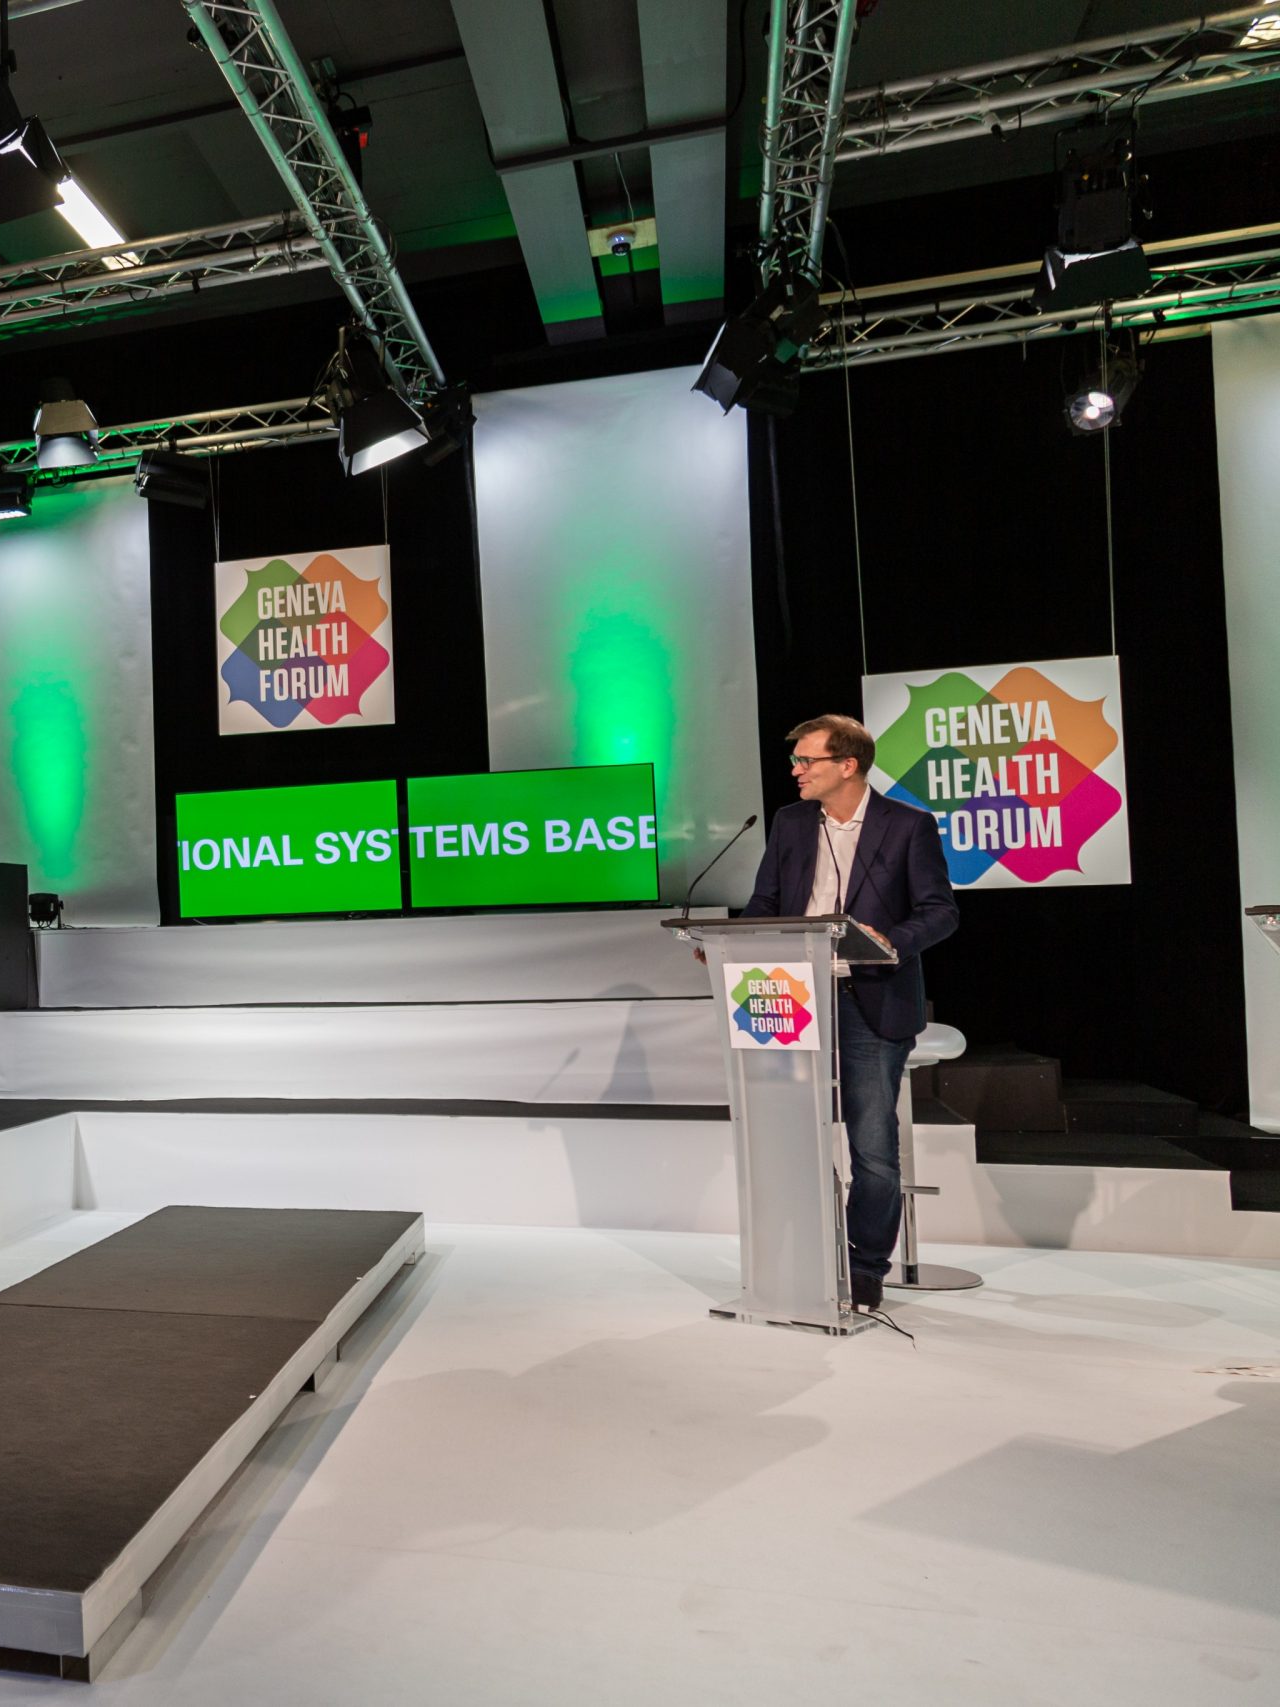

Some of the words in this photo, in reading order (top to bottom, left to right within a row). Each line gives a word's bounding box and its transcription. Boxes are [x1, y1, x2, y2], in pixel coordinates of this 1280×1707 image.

[257, 580, 346, 620] GENEVA
[258, 622, 348, 661] HEALTH
[259, 664, 349, 702] FORUM
[925, 700, 1056, 748] GENEVA
[927, 753, 1060, 800] HEALTH
[177, 834, 304, 871] IONAL
[748, 979, 791, 995] GENEVA
[749, 998, 793, 1014] HEALTH
[751, 1017, 795, 1033] FORUM
